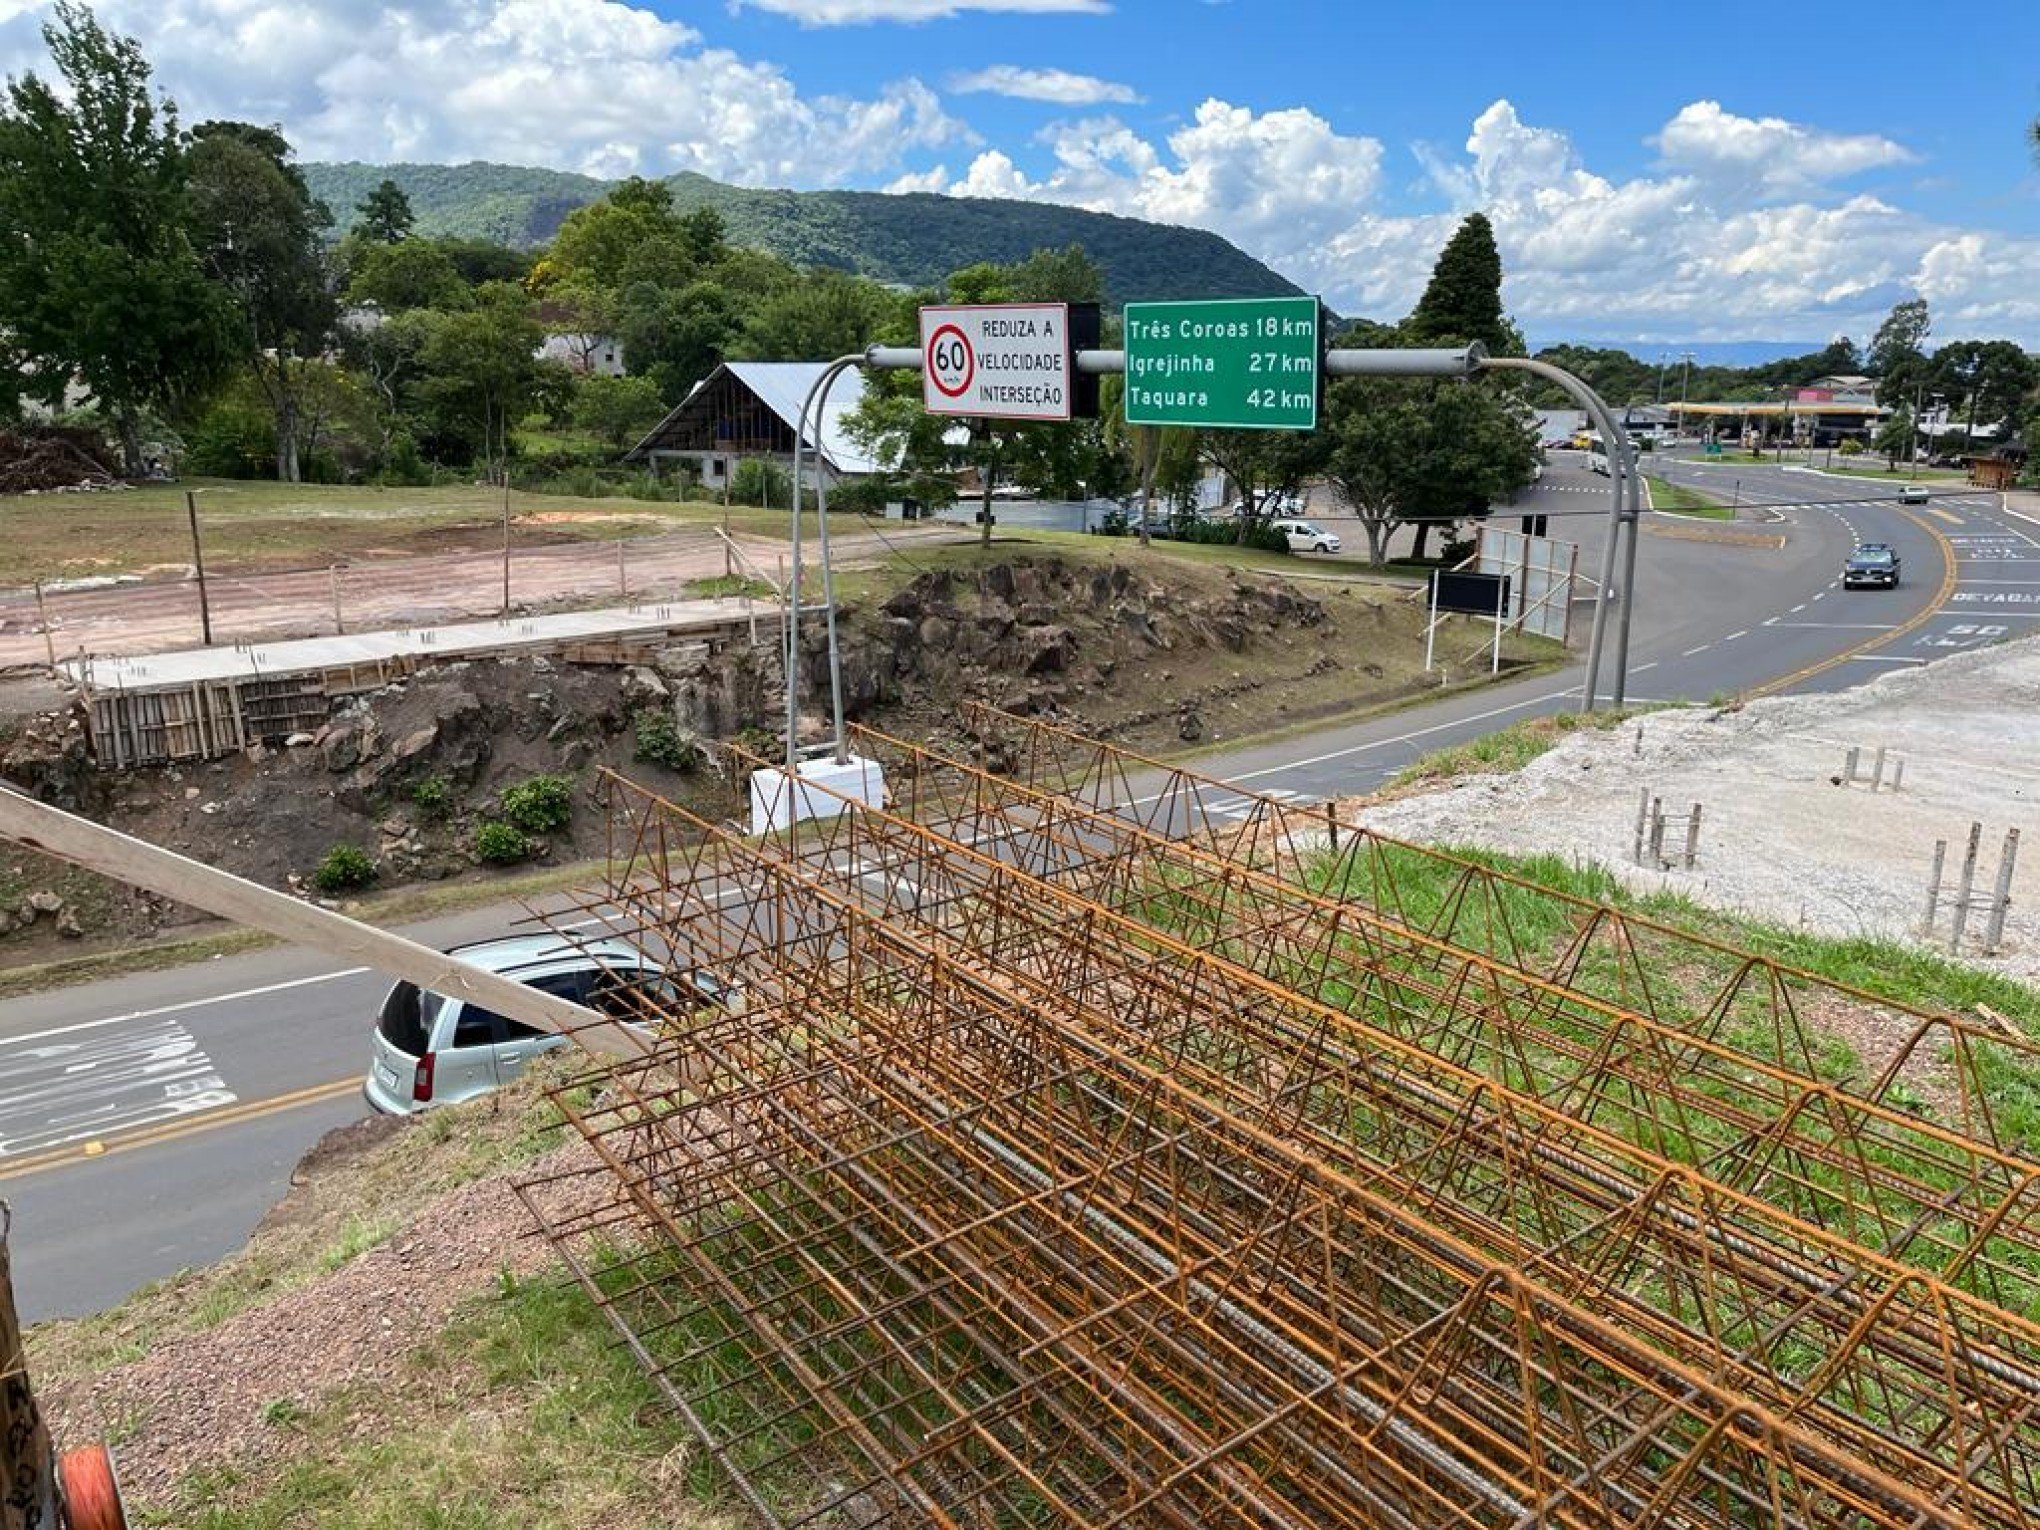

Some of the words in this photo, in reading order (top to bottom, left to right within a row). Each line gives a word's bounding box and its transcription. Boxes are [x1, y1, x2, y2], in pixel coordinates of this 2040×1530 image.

[981, 320, 1036, 338] REDUZA
[1043, 320, 1053, 338] A
[1130, 320, 1170, 339] Três
[1179, 320, 1249, 338] Coroas
[1256, 316, 1278, 337] 18
[1282, 317, 1312, 336] km
[936, 341, 964, 371] 60
[977, 354, 1062, 371] VELOCIDADE
[1129, 354, 1215, 377] Igrejinha
[1249, 352, 1277, 372] 27
[1282, 353, 1311, 372] km
[980, 382, 1062, 406] INTERSEÇÃO
[1131, 387, 1208, 409] Taquara
[1246, 388, 1276, 408] 42
[1281, 389, 1311, 409] km
